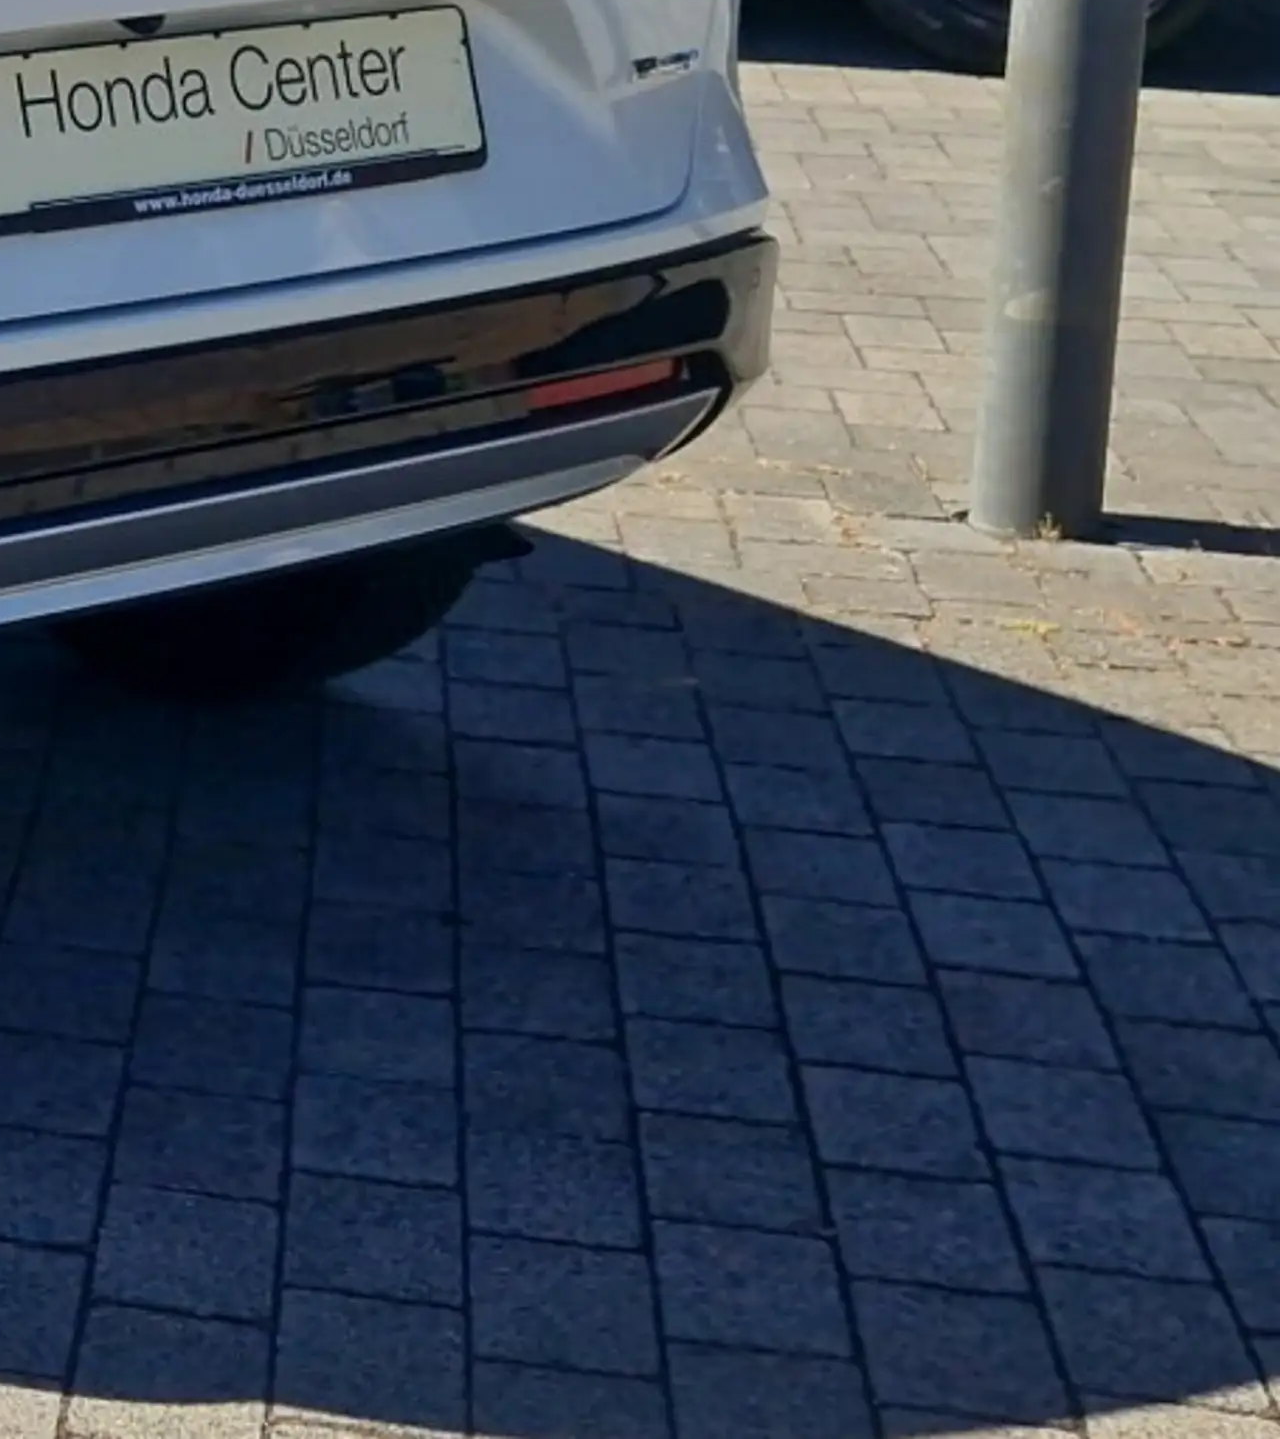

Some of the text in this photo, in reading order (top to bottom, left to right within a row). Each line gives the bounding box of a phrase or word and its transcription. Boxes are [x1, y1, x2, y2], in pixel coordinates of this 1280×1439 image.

[16, 40, 406, 138] Honda Center
[264, 111, 410, 162] Düsseldorf
